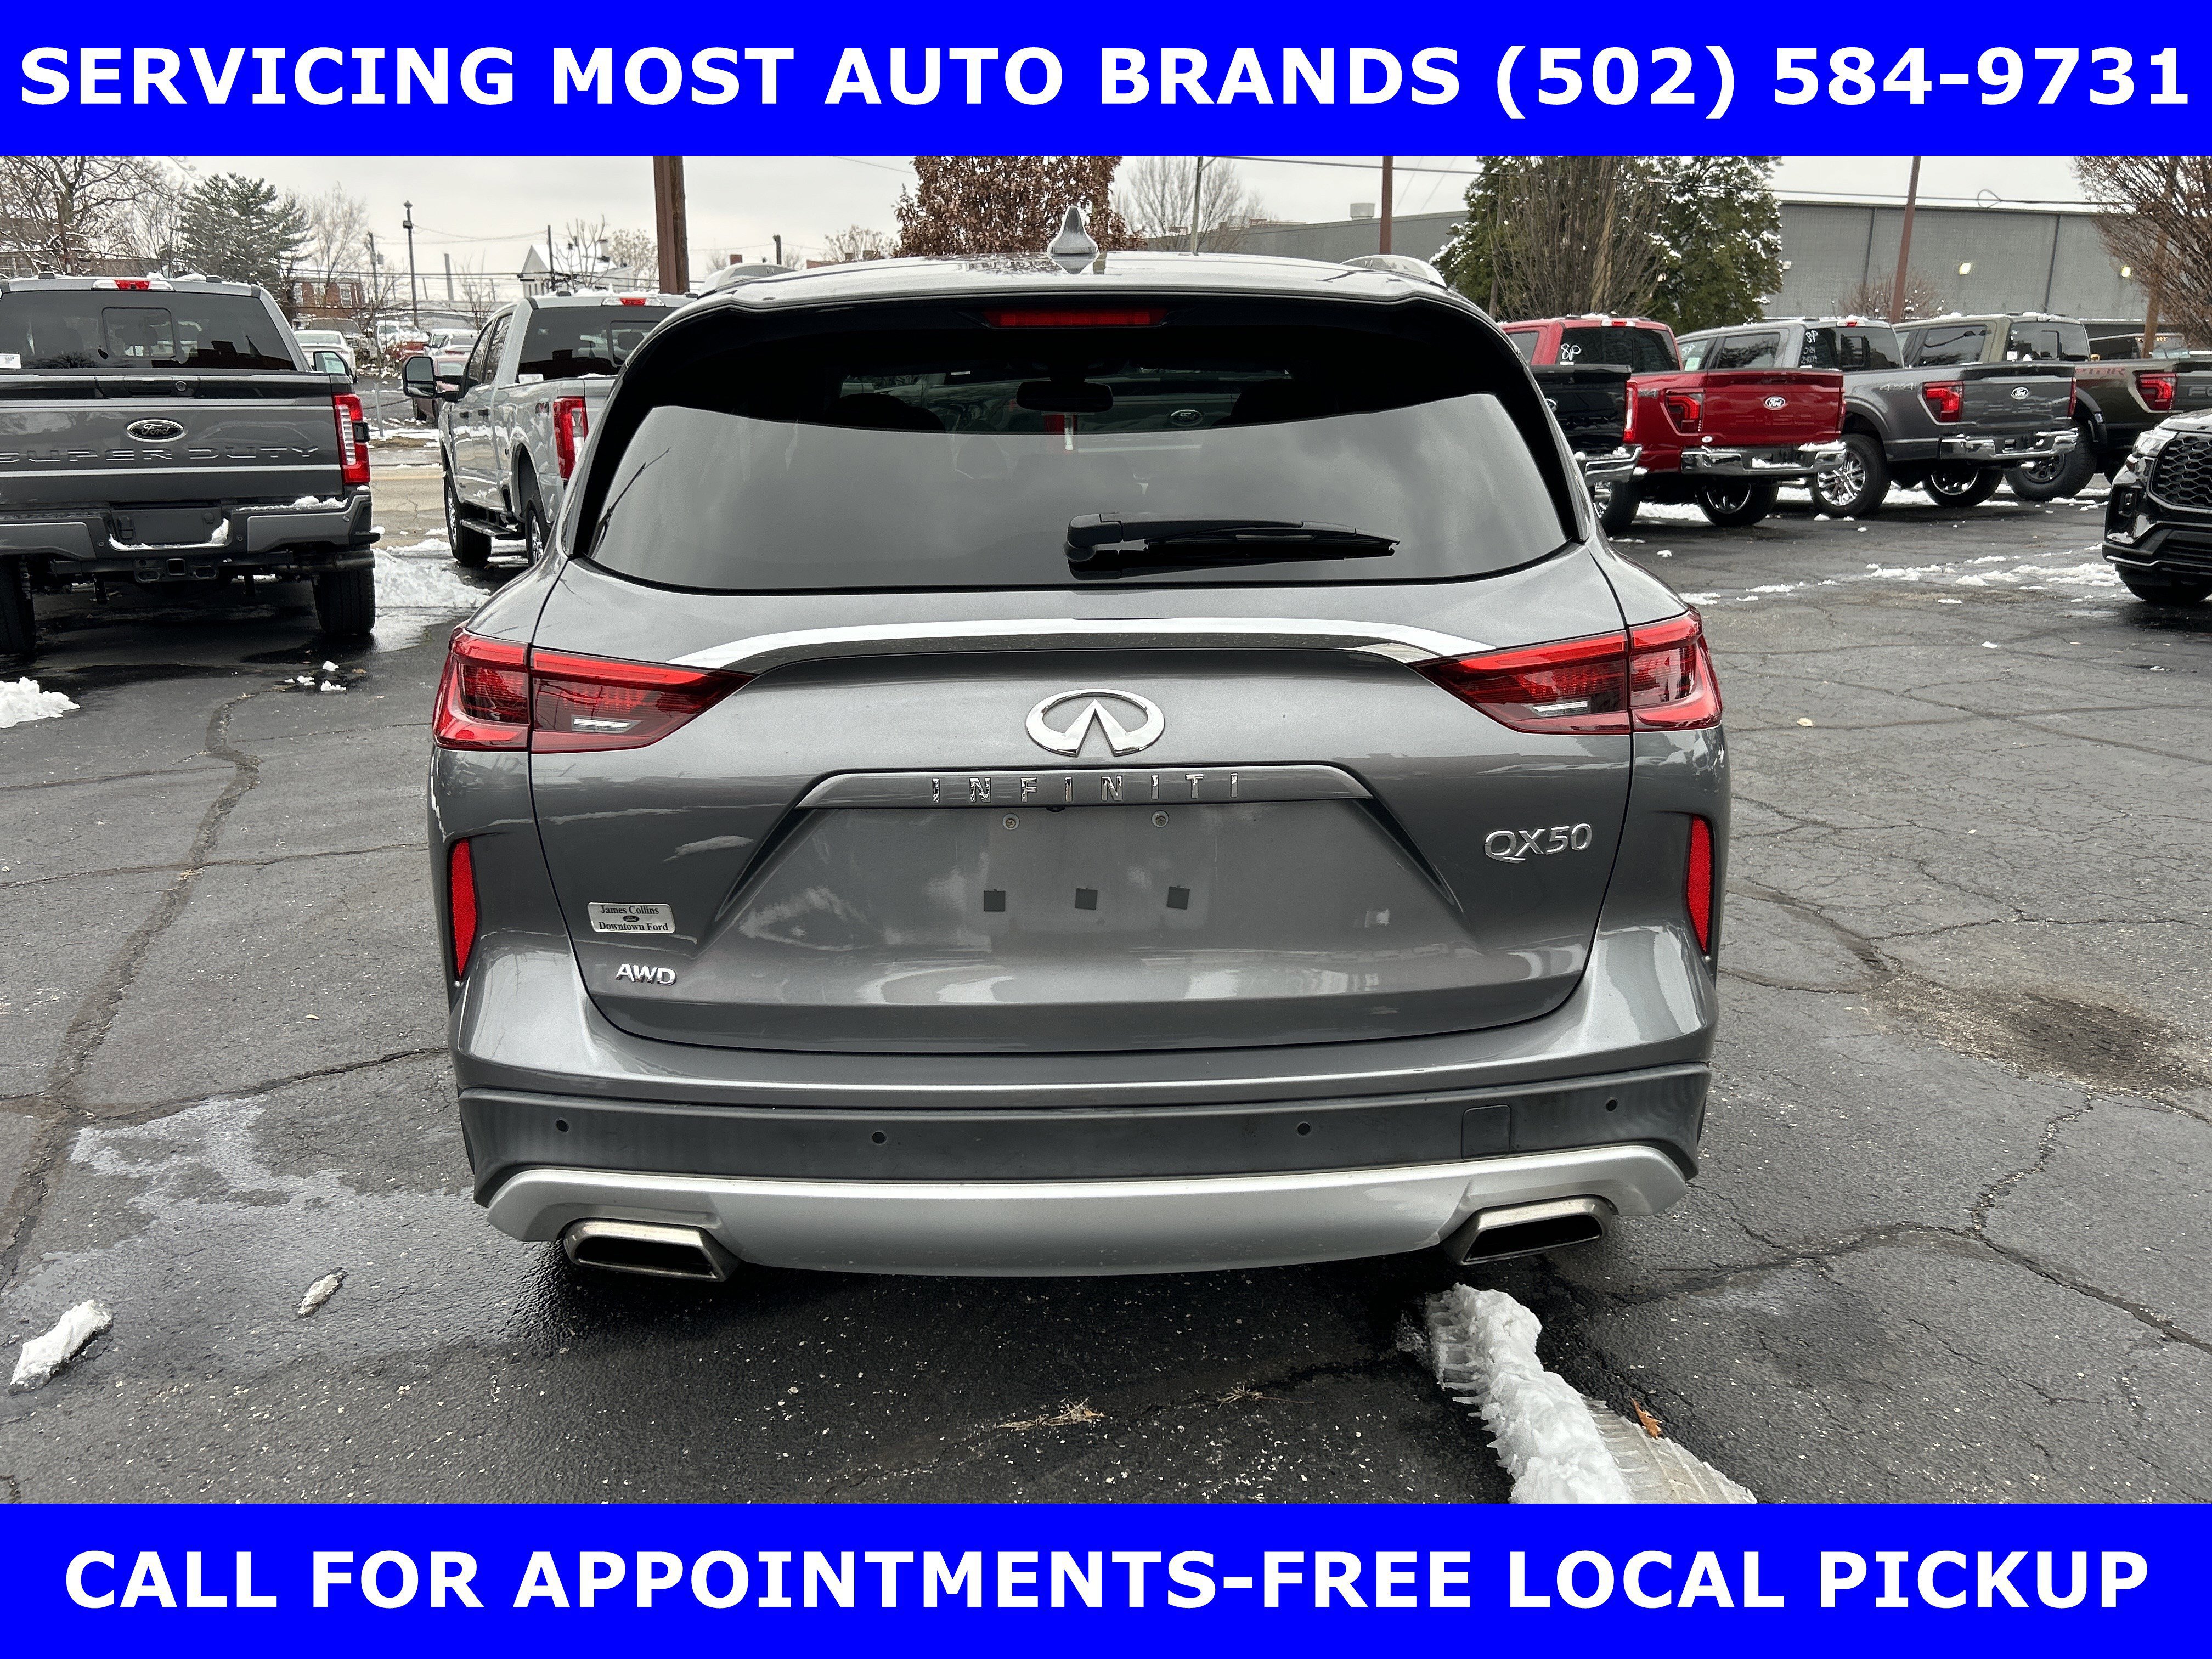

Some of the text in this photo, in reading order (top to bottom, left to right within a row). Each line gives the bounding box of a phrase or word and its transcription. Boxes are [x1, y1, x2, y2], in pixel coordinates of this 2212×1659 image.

[1561, 343, 1582, 361] 8P
[140, 423, 171, 436] Ford
[0, 445, 319, 463] SUPER DUTY
[932, 772, 1239, 803] INFINITI
[1485, 823, 1592, 864] QX50
[600, 905, 659, 914] James Collins
[599, 922, 668, 931] Downtown Ford
[616, 963, 677, 986] AWD
